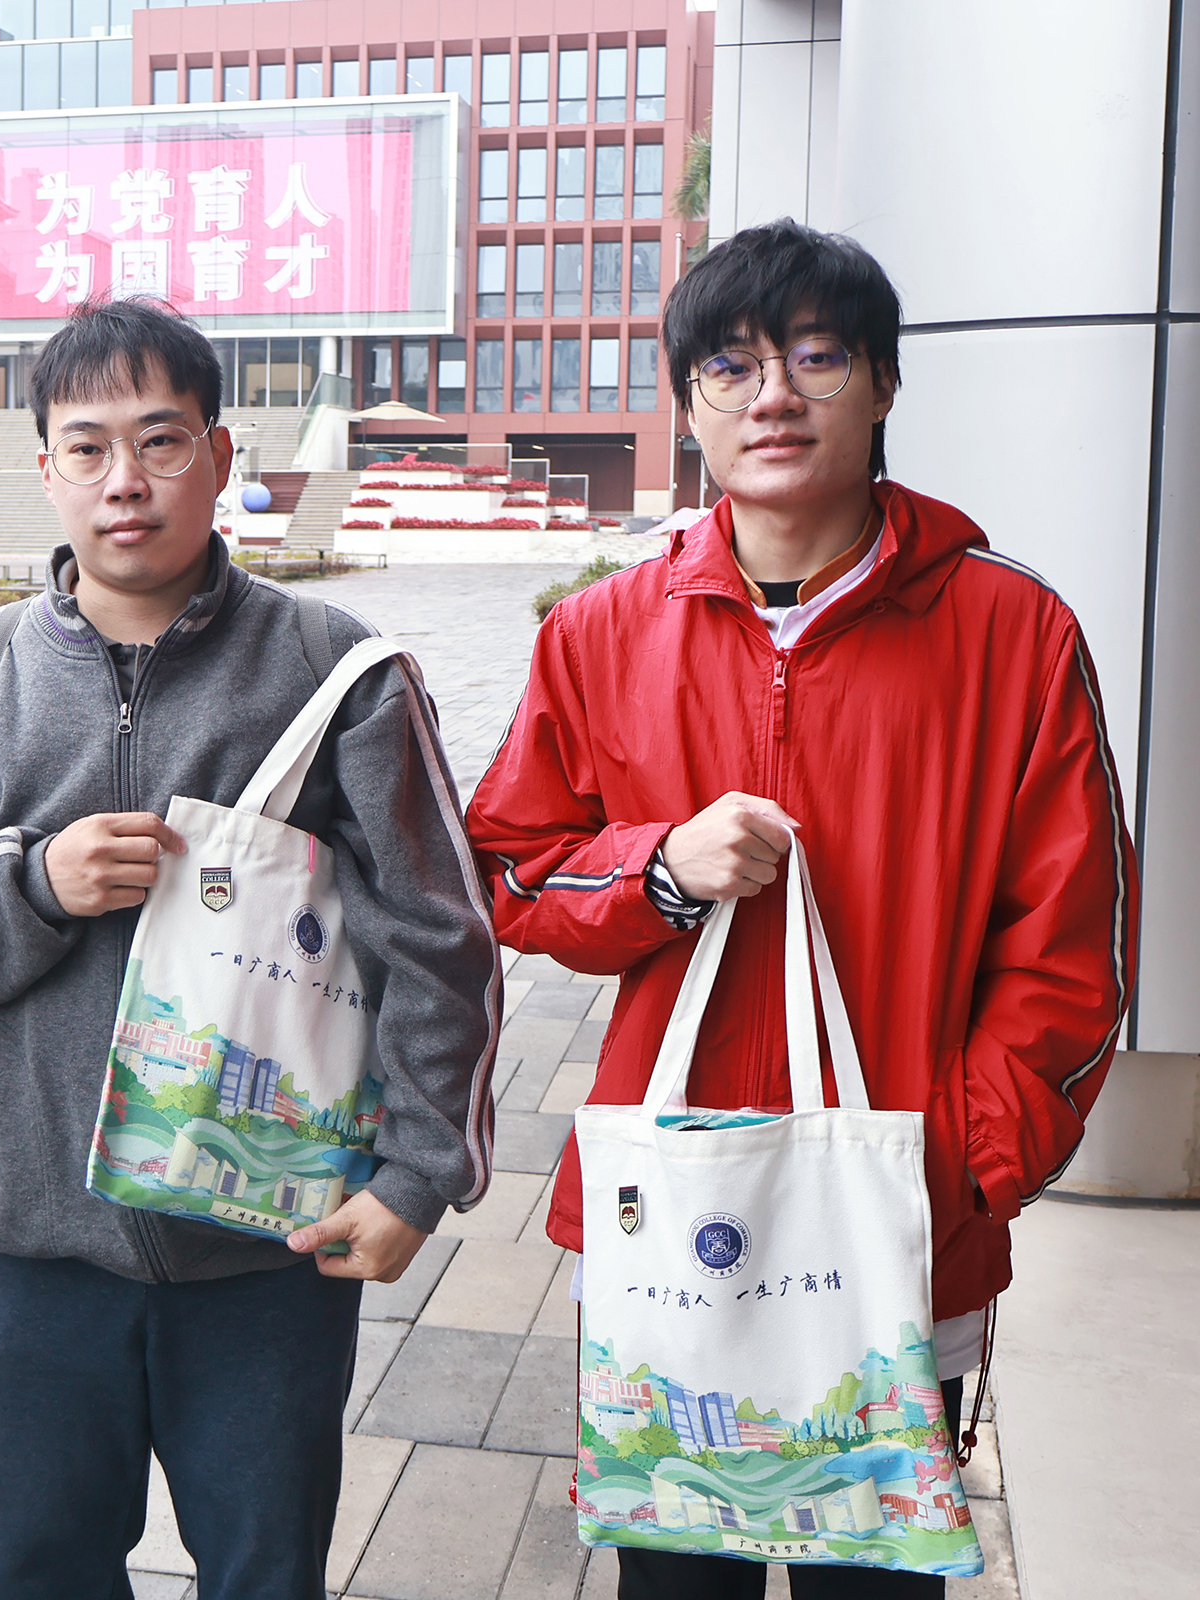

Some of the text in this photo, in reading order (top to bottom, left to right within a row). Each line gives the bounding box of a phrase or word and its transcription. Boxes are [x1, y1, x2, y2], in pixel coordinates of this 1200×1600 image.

[35, 162, 332, 235] 为党育人
[35, 233, 330, 303] 为国育才
[210, 951, 298, 983] 一日广商人
[223, 1206, 282, 1231] 广州商学院
[698, 1215, 727, 1226] COLLEGE
[727, 1216, 737, 1225] OF
[735, 1222, 749, 1257] COMMERCE
[707, 1229, 726, 1239] GCC
[627, 1269, 843, 1310] 一日广商人 一生广商情
[740, 1538, 811, 1554] 广州商学院
